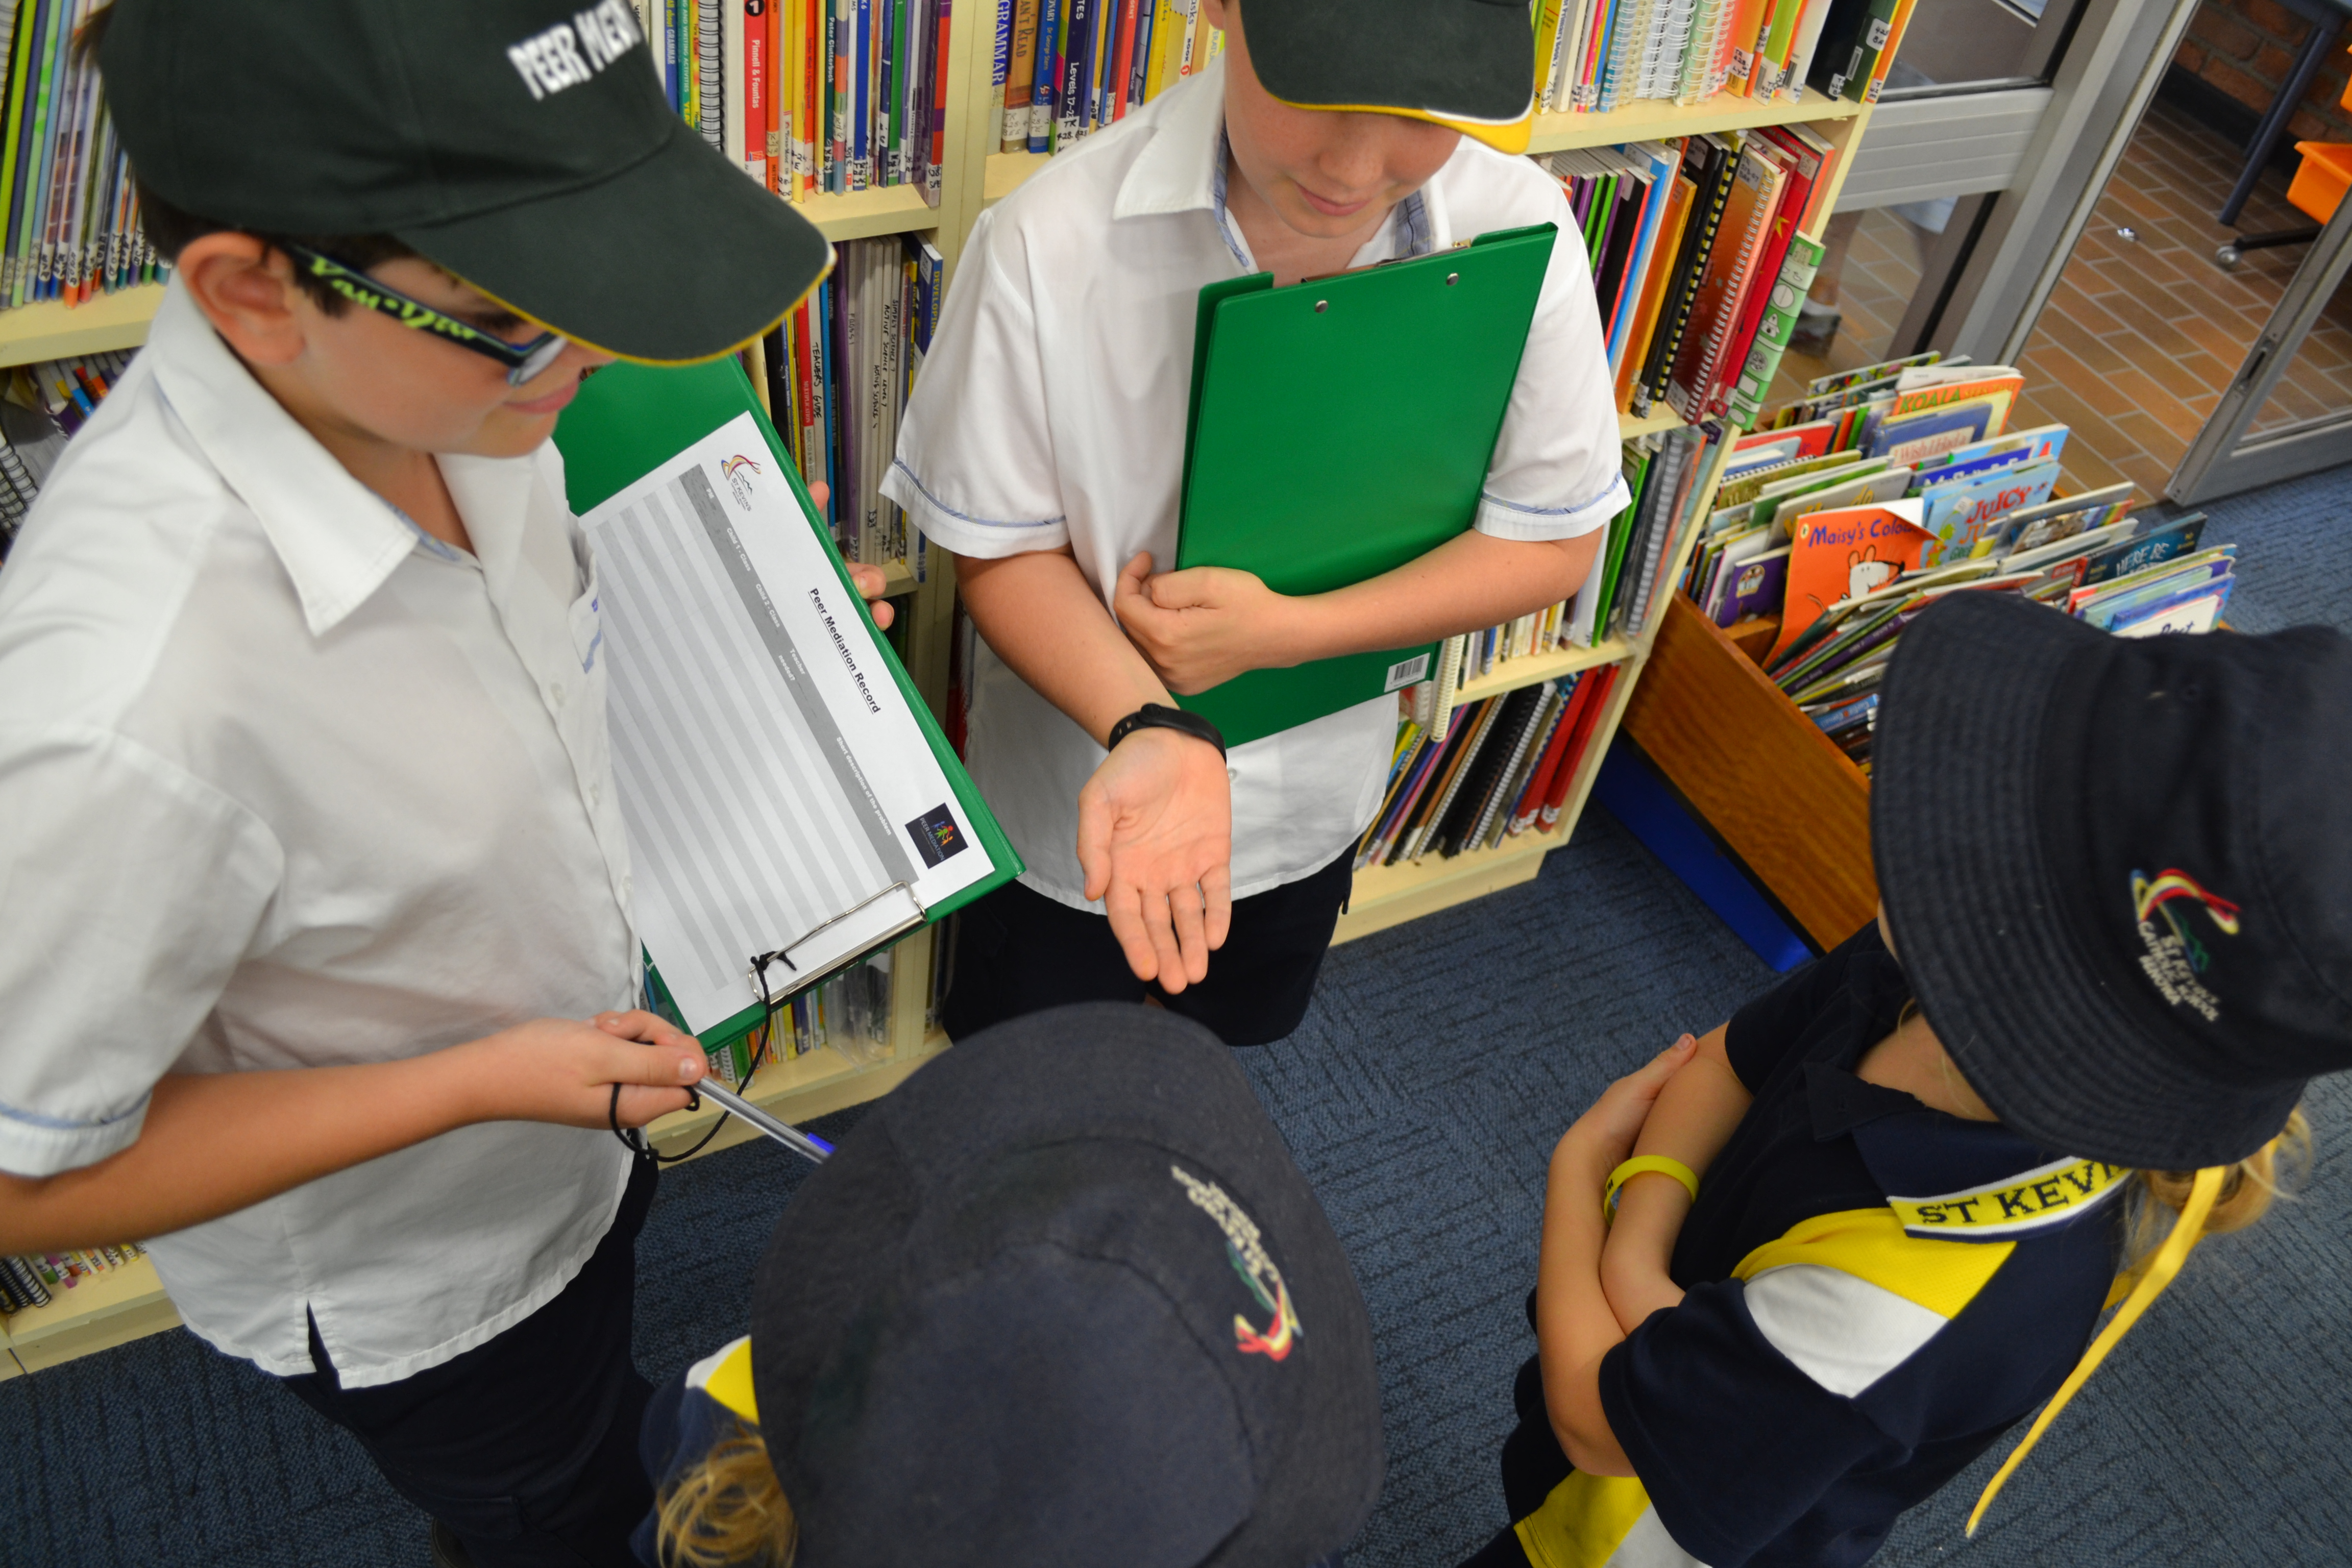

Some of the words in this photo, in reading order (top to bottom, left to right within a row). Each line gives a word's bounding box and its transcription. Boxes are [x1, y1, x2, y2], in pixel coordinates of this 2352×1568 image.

[1557, 8, 1567, 40] Primary
[992, 0, 1010, 86] GRAMMAR
[1553, 41, 1562, 62] Book
[507, 22, 593, 101] PEER
[1067, 62, 1079, 94] Levels
[930, 271, 940, 335] DEVELOPING
[883, 305, 891, 336] ACTIVE
[812, 342, 821, 387] TEACHERS
[813, 396, 822, 419] GUIDE
[1898, 387, 1961, 415] KOALA
[732, 478, 739, 486] ST
[737, 486, 751, 511] KEVIN'S
[1965, 486, 2033, 523] JUICY
[727, 528, 739, 544] Child
[740, 553, 751, 572] Class
[1808, 522, 1866, 548] Maisy's
[756, 583, 768, 600] Child
[769, 609, 780, 628] Class
[790, 649, 805, 675] Teacher
[810, 589, 827, 614] Peer
[825, 616, 856, 672] Mediation
[854, 672, 881, 713] Record
[778, 655, 795, 681] needed?
[837, 737, 848, 755] Short
[846, 755, 867, 791] description
[865, 790, 872, 798] of
[875, 808, 891, 836] problem
[920, 817, 929, 832] PEER
[927, 831, 945, 861] MEDIATION
[1917, 1197, 1979, 1223] ST
